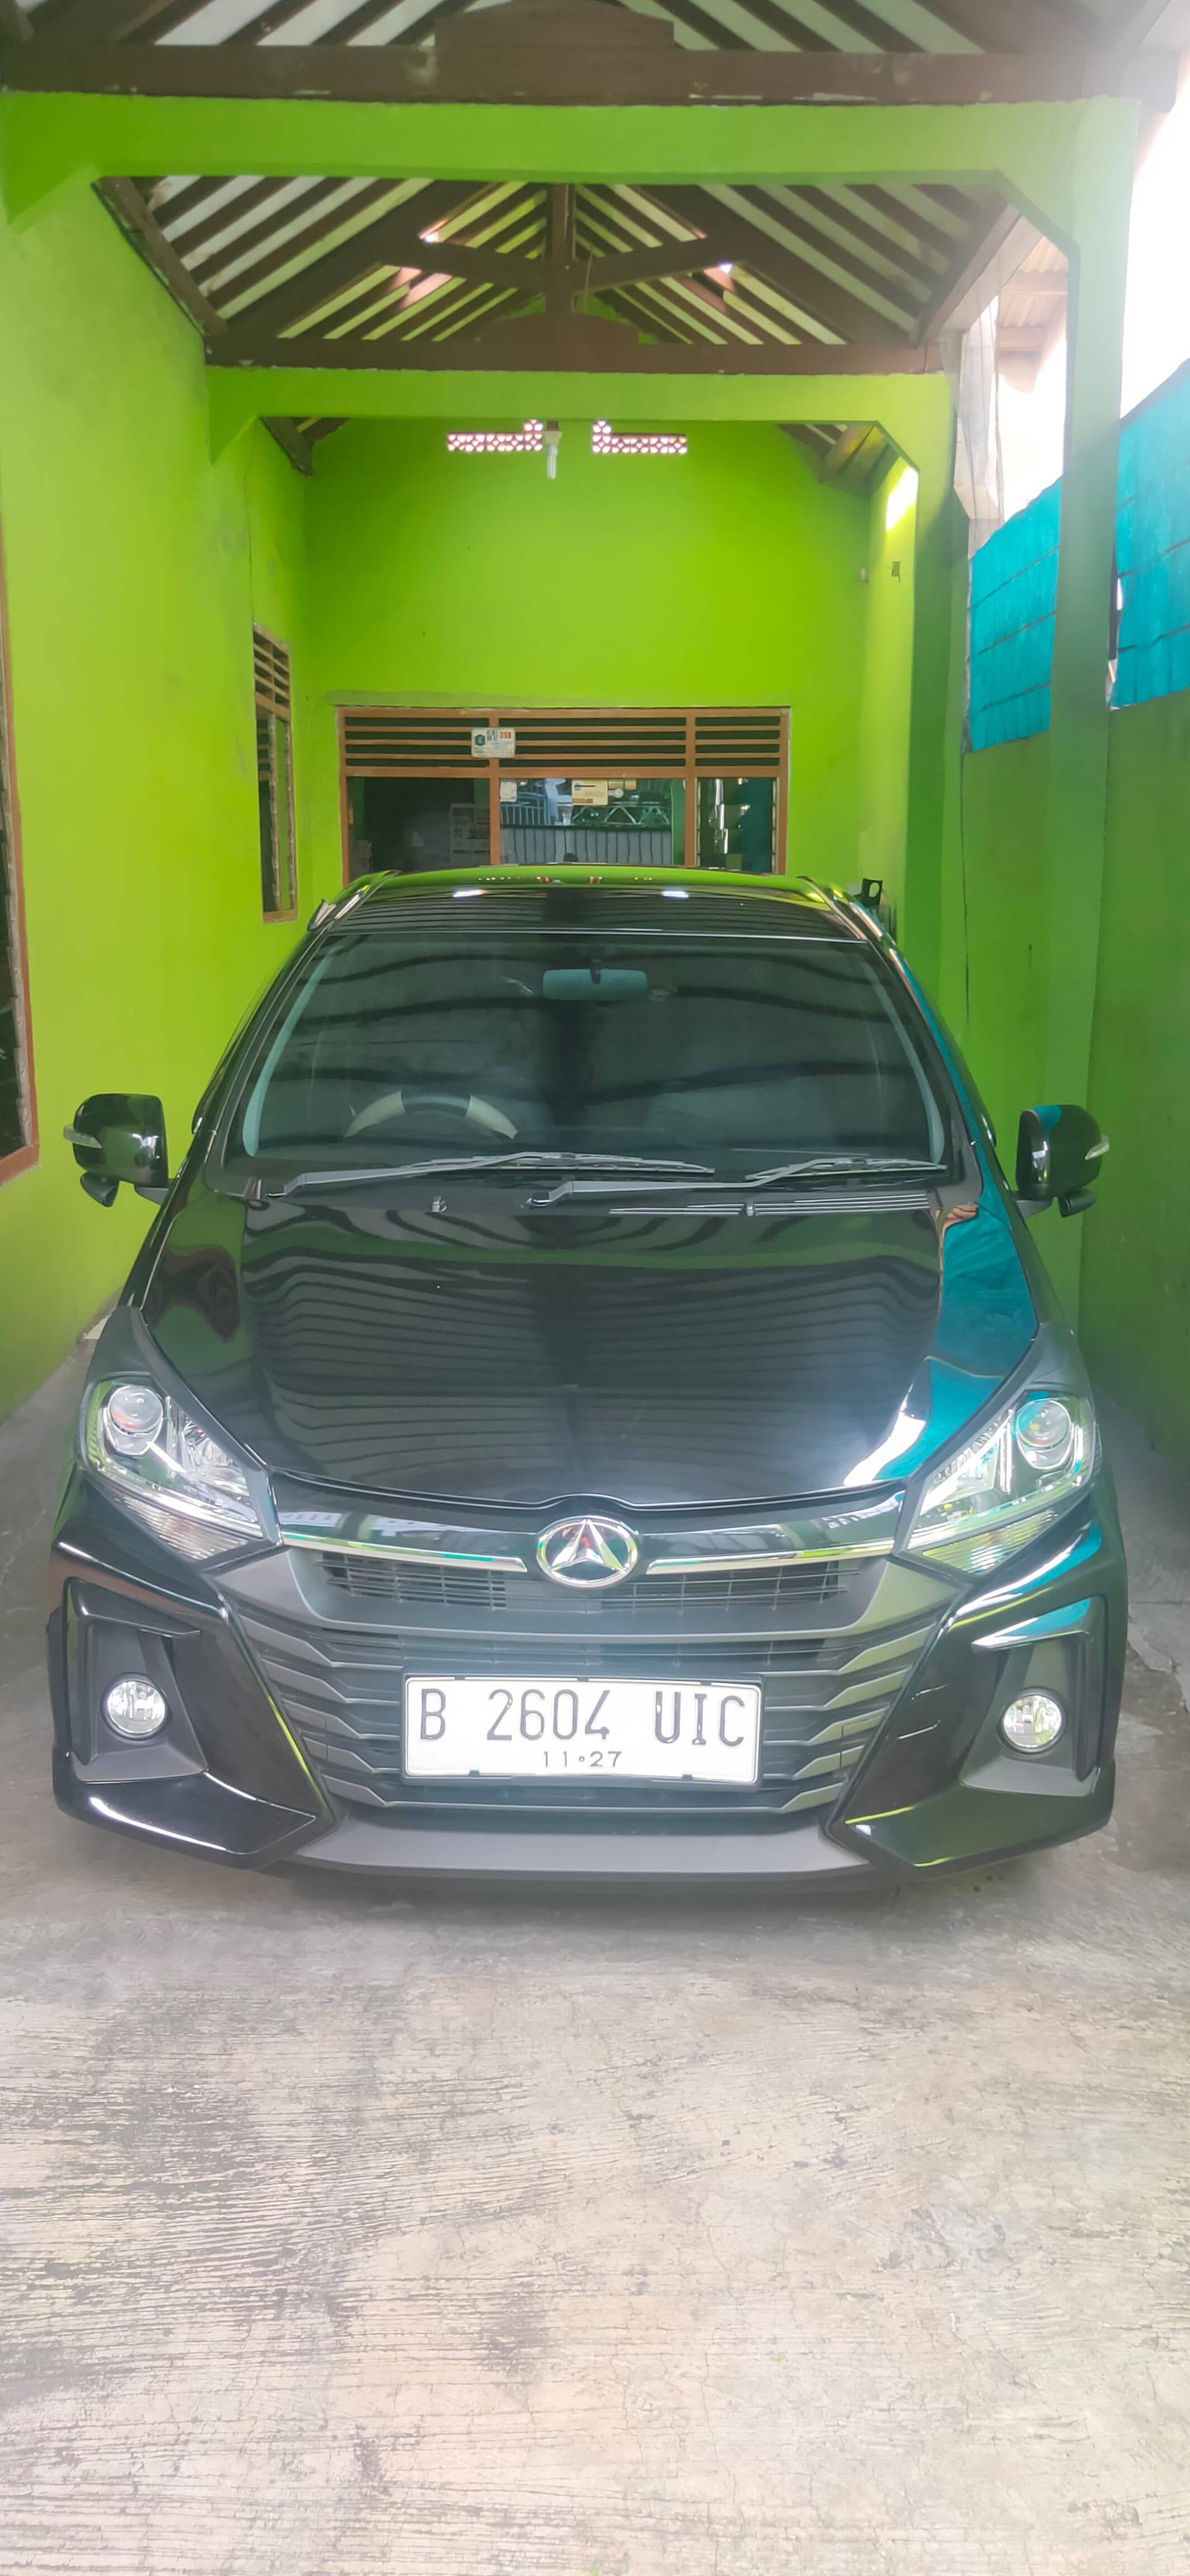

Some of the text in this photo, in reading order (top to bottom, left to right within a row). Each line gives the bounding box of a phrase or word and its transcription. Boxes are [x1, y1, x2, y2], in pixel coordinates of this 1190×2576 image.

[420, 1688, 745, 1747] B 2604 UIC
